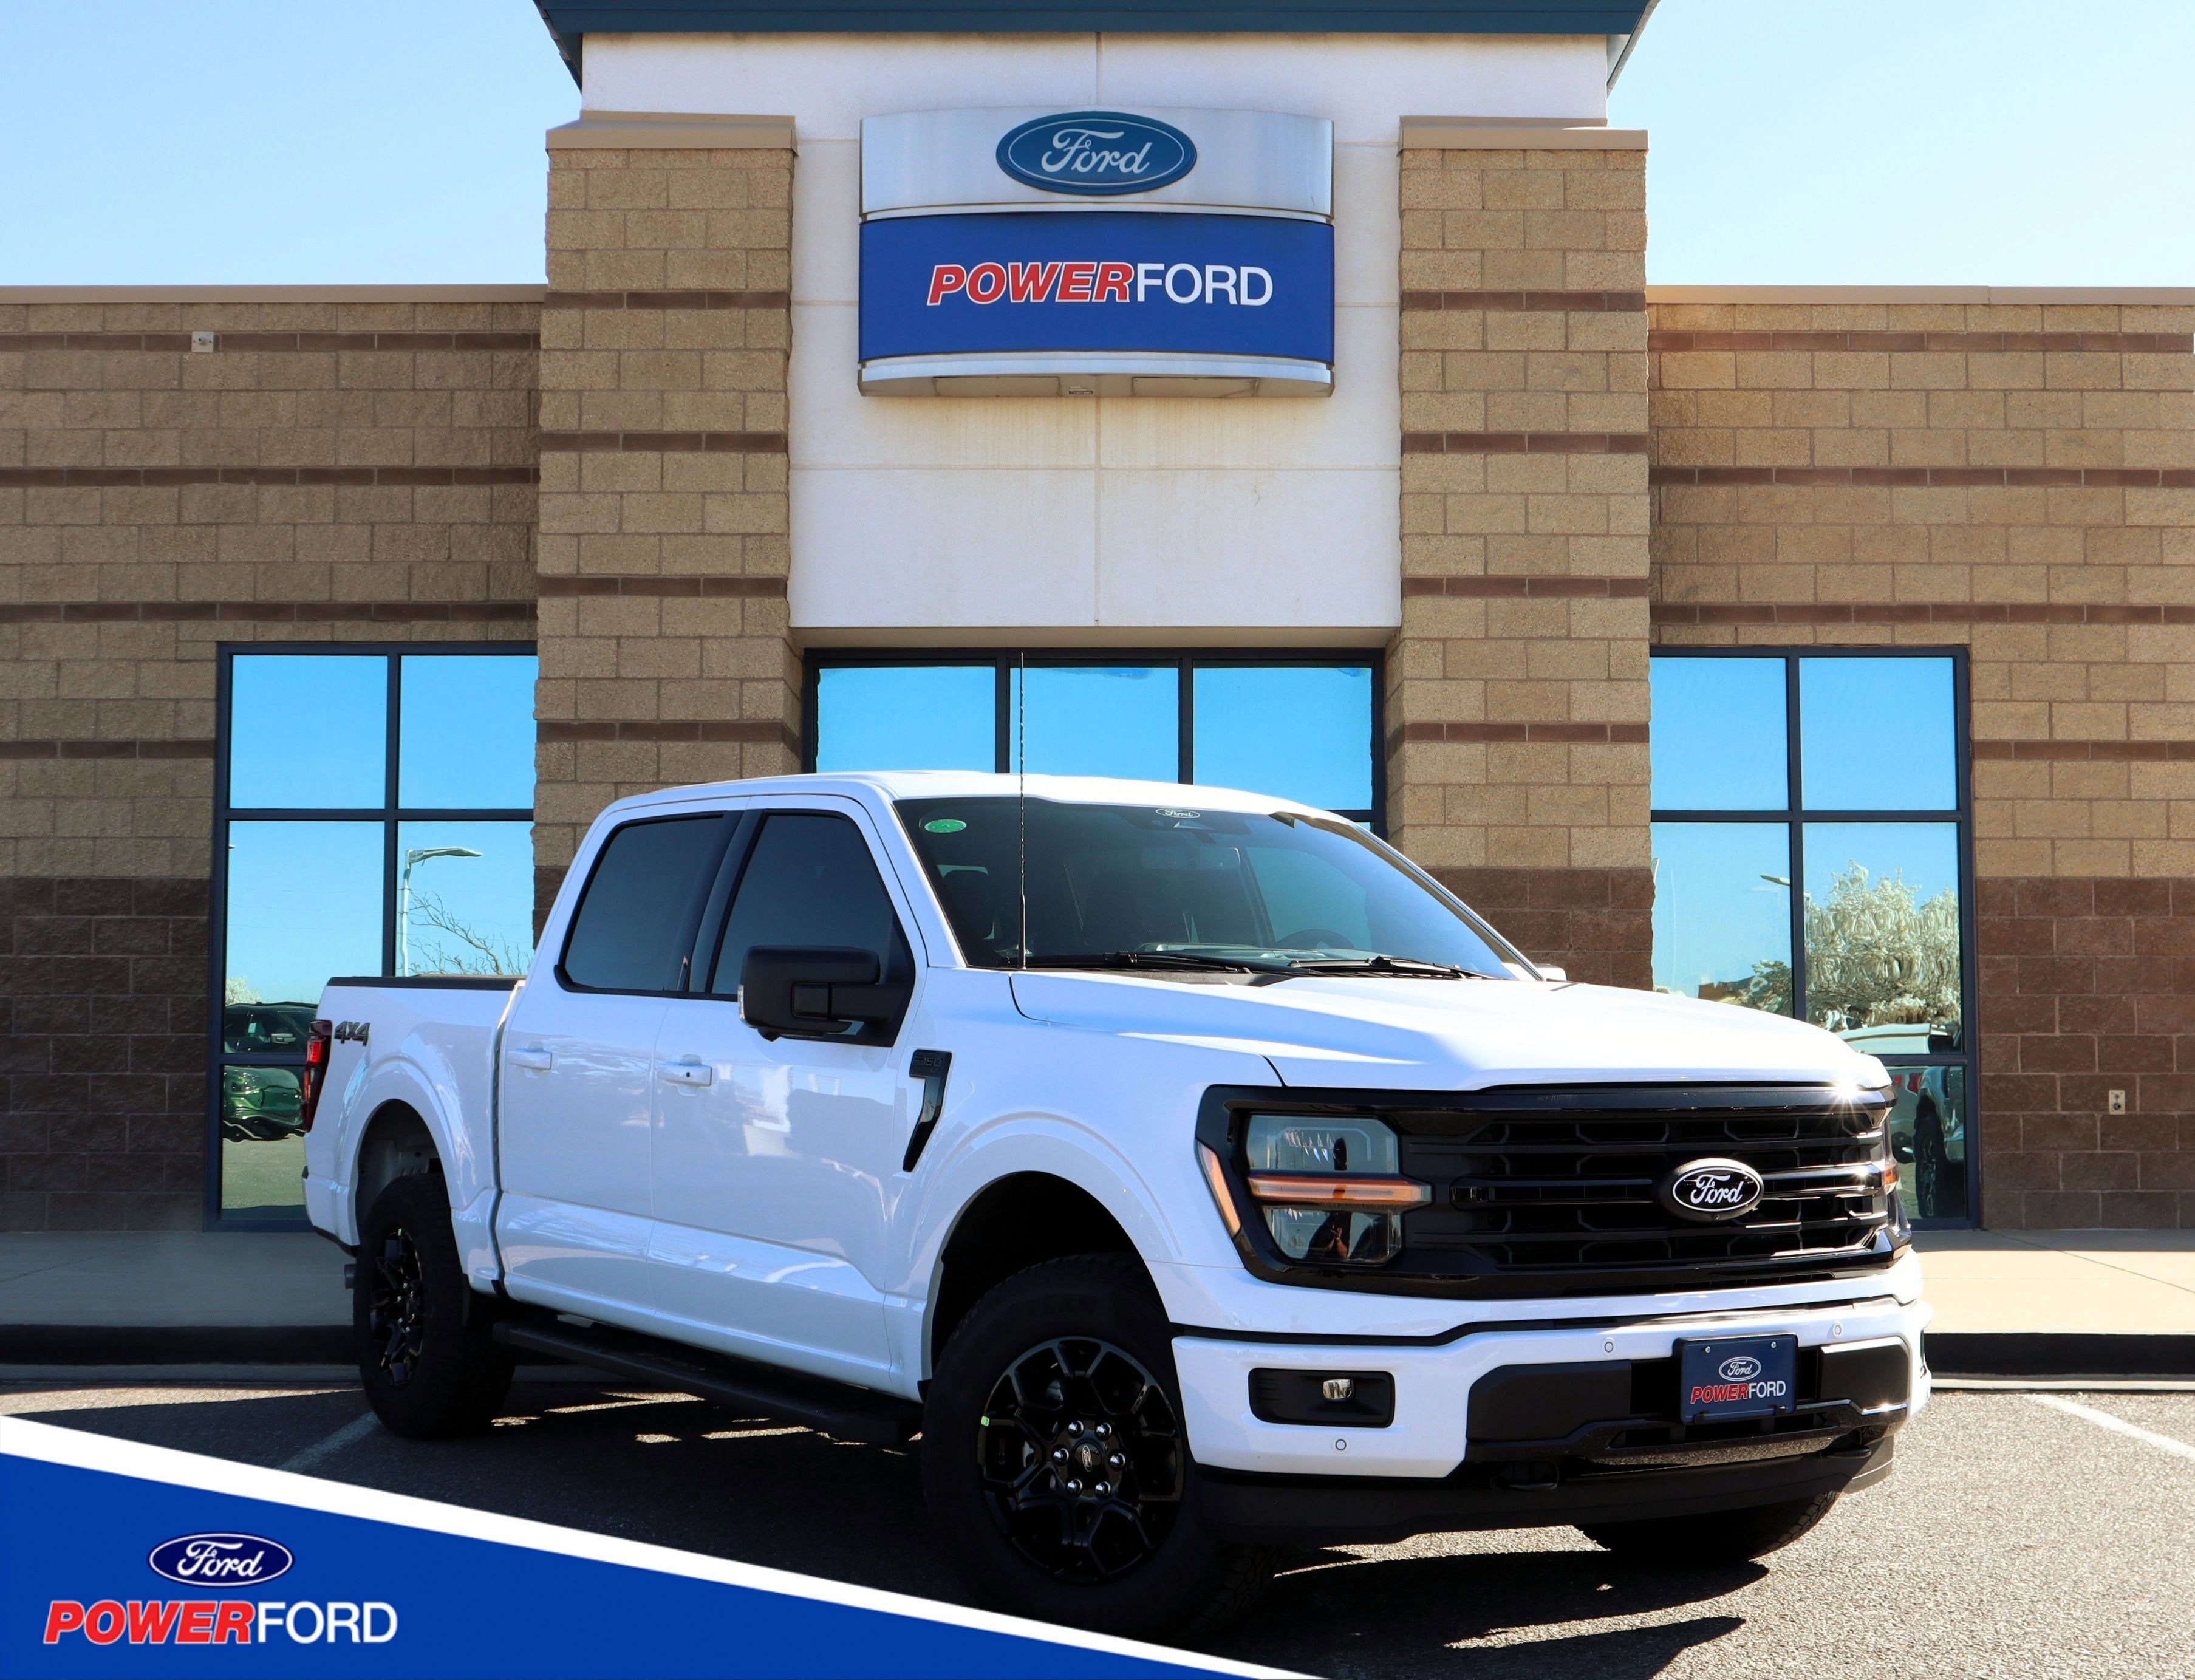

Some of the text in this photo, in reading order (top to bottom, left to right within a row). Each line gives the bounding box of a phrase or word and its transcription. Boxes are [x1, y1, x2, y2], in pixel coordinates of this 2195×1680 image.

[1041, 128, 1152, 174] Ford
[1690, 1174, 1744, 1204] Ford
[1727, 1361, 1753, 1376] Ford
